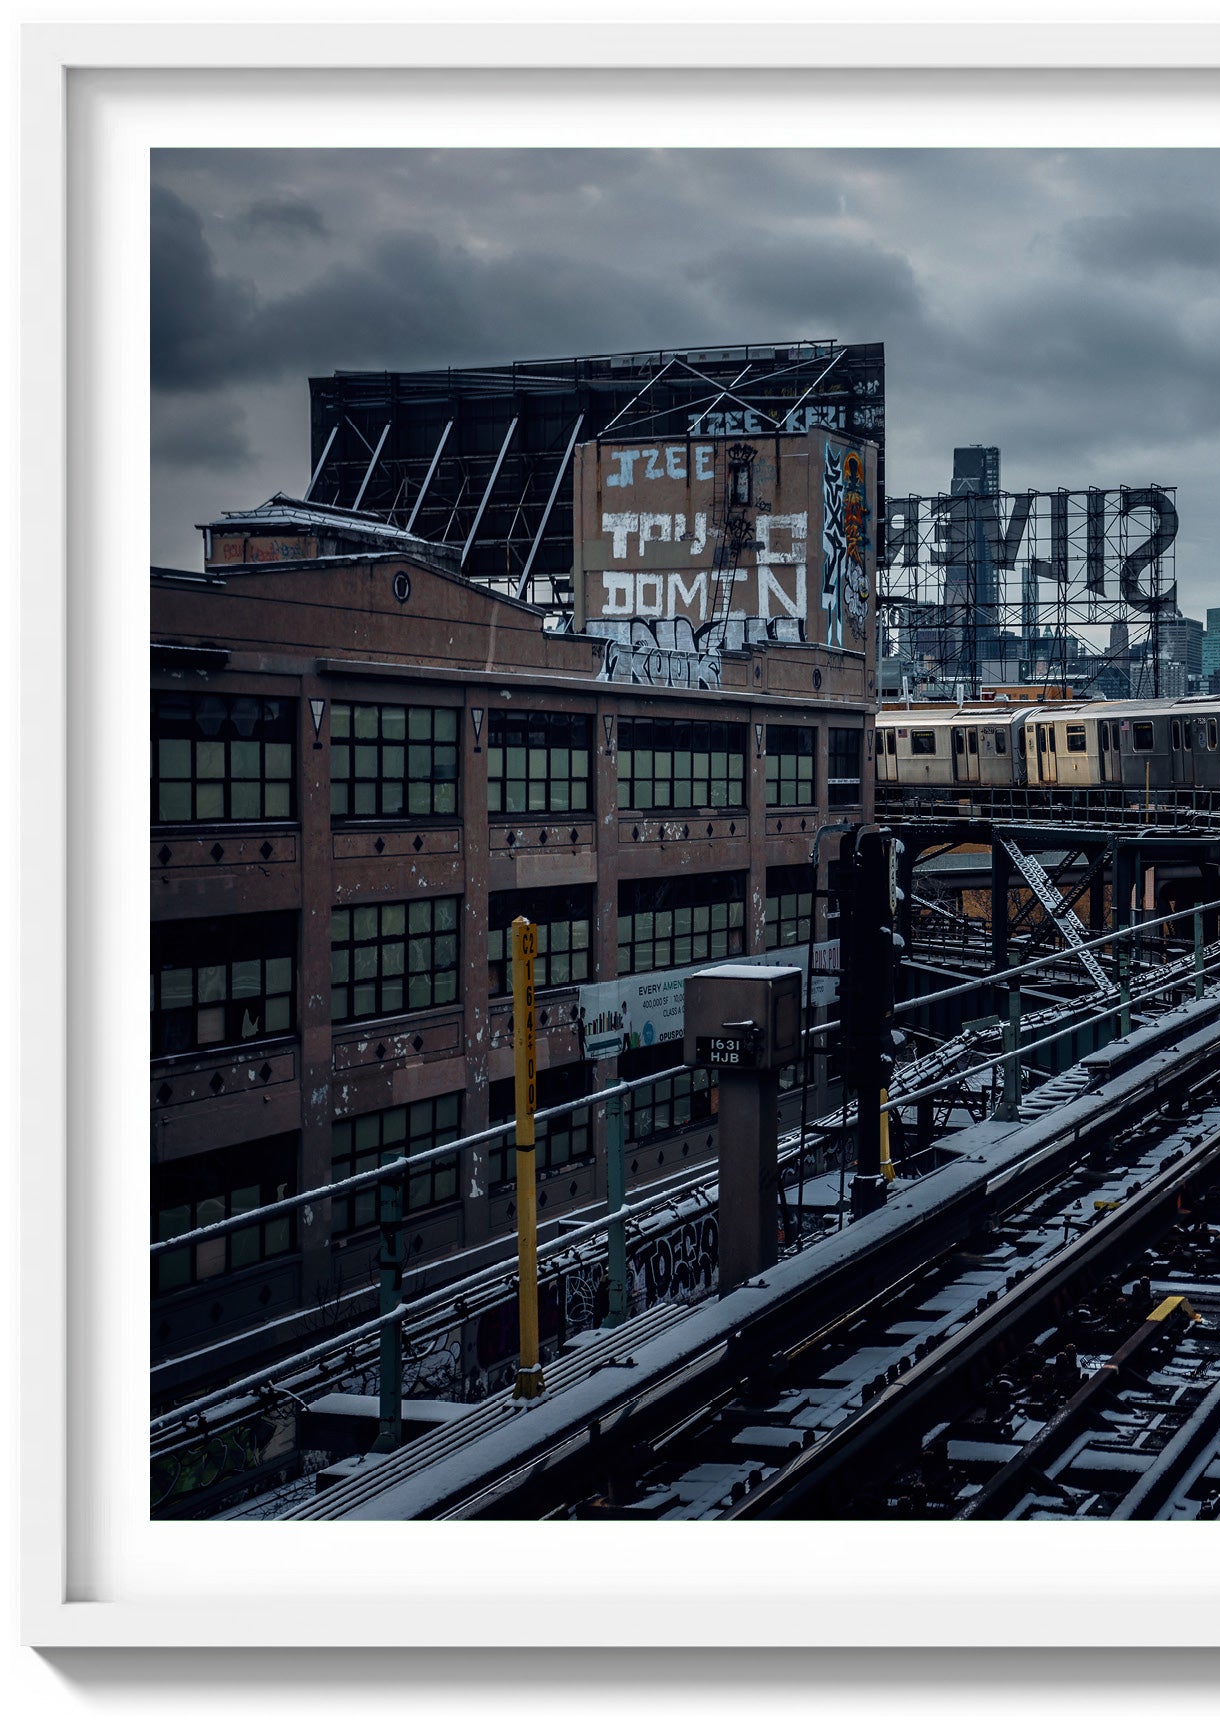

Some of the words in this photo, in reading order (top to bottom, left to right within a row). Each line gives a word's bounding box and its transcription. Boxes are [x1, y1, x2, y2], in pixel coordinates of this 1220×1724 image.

[522, 934, 534, 955] C2
[638, 983, 662, 996] EVERY
[662, 980, 684, 991] AMEN
[662, 1007, 678, 1018] CLASS
[659, 1029, 685, 1042] OPUSPO
[710, 1039, 740, 1051] 1631
[710, 1051, 739, 1064] HJB
